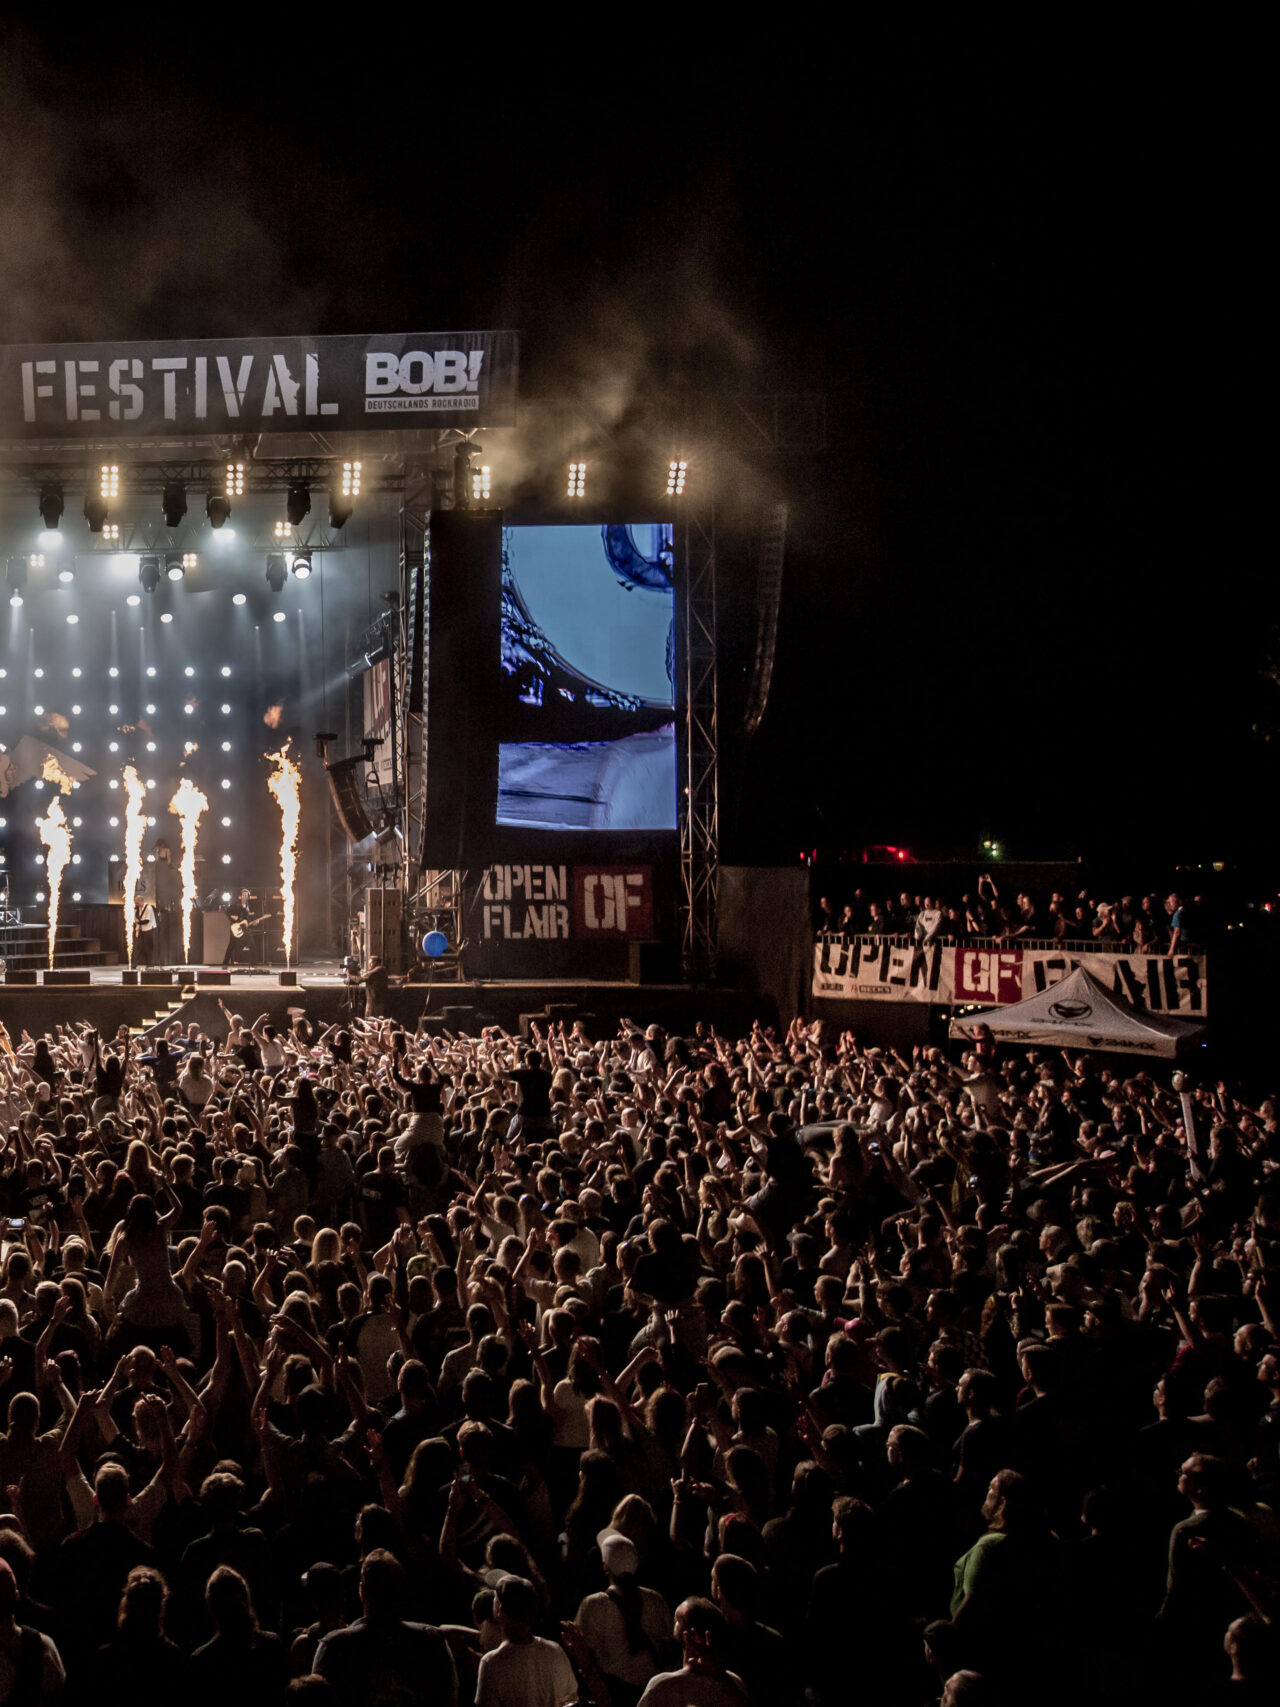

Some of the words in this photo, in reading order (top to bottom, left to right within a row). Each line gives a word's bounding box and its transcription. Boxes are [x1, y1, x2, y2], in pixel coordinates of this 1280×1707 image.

[21, 353, 339, 422] FESTIVAL
[366, 350, 484, 394] BOB!
[367, 400, 429, 410] DEUTSCHLANDS
[432, 398, 476, 408] ROCKRADIO
[483, 865, 567, 900] OPEN
[583, 873, 644, 931] OF
[483, 904, 569, 939] FLAIR
[820, 941, 943, 991] OPEN
[963, 952, 1017, 1003] OF
[1033, 957, 1202, 1012] FAIR
